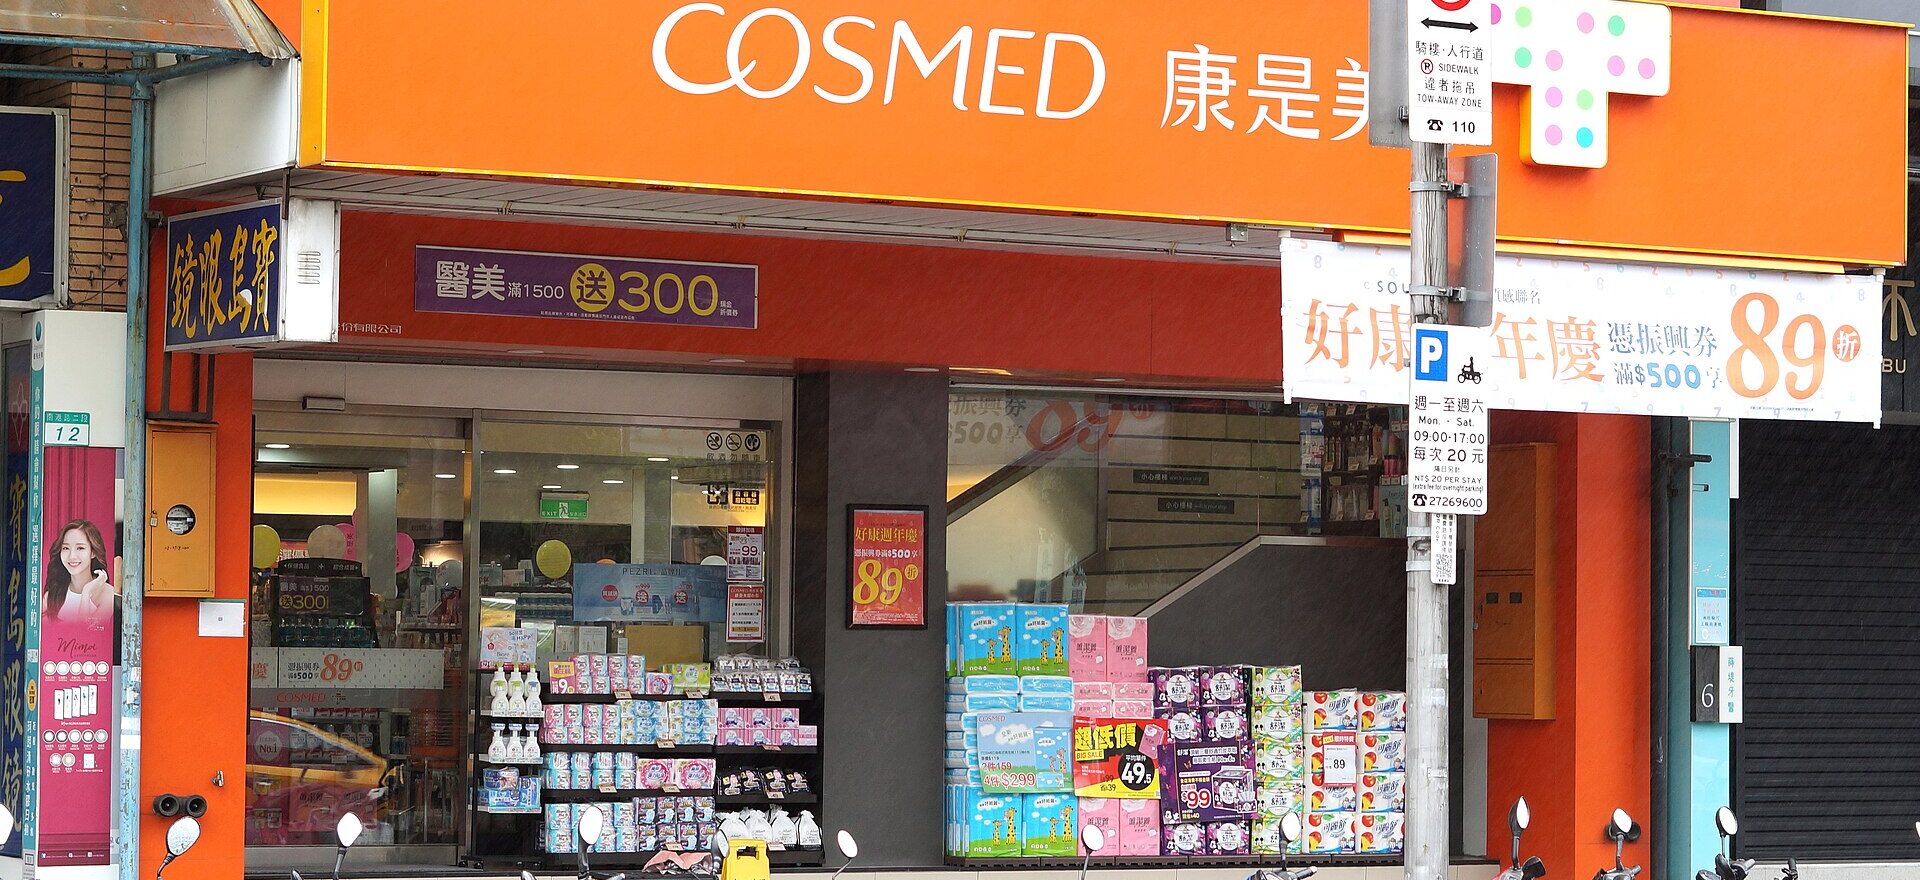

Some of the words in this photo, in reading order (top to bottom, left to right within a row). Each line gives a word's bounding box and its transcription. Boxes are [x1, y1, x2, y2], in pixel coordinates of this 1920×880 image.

[651, 2, 1106, 120] COSMED
[1438, 63, 1479, 75] SIDEWALK
[1424, 77, 1475, 94] 違者拖吊
[1417, 94, 1458, 105] TOW-AWAY
[1461, 98, 1482, 108] ZONE
[1452, 121, 1475, 133] 110
[436, 260, 505, 301] 醫美
[508, 282, 564, 299] 滿1500
[577, 270, 607, 305] 送
[618, 270, 719, 317] 300
[338, 322, 402, 335] 份有限公司
[1607, 322, 1718, 357] 憑振興券
[1726, 292, 1826, 400] 89
[1838, 330, 1857, 360] 折
[1420, 336, 1443, 374] P
[945, 398, 1026, 417] 振興券
[1414, 396, 1484, 414] 週一至週六
[1418, 416, 1440, 425] Mon.
[1456, 417, 1475, 427] Sat.
[56, 427, 80, 442] 12
[1414, 431, 1485, 444] 09:00-17:00
[1414, 446, 1442, 462] 每次
[1447, 449, 1467, 462] 20
[1471, 451, 1484, 464] 元
[1431, 475, 1442, 483] 20
[1429, 496, 1483, 508] 27269600
[855, 527, 918, 543] 好康週年慶
[853, 559, 903, 605] 89
[321, 653, 352, 682] 89
[277, 692, 326, 703] COSMED
[1701, 683, 1714, 708] 6
[1075, 723, 1137, 751] 超低價
[1088, 750, 1103, 759] SALE
[1333, 759, 1346, 769] 89
[1121, 762, 1152, 784] 49.5
